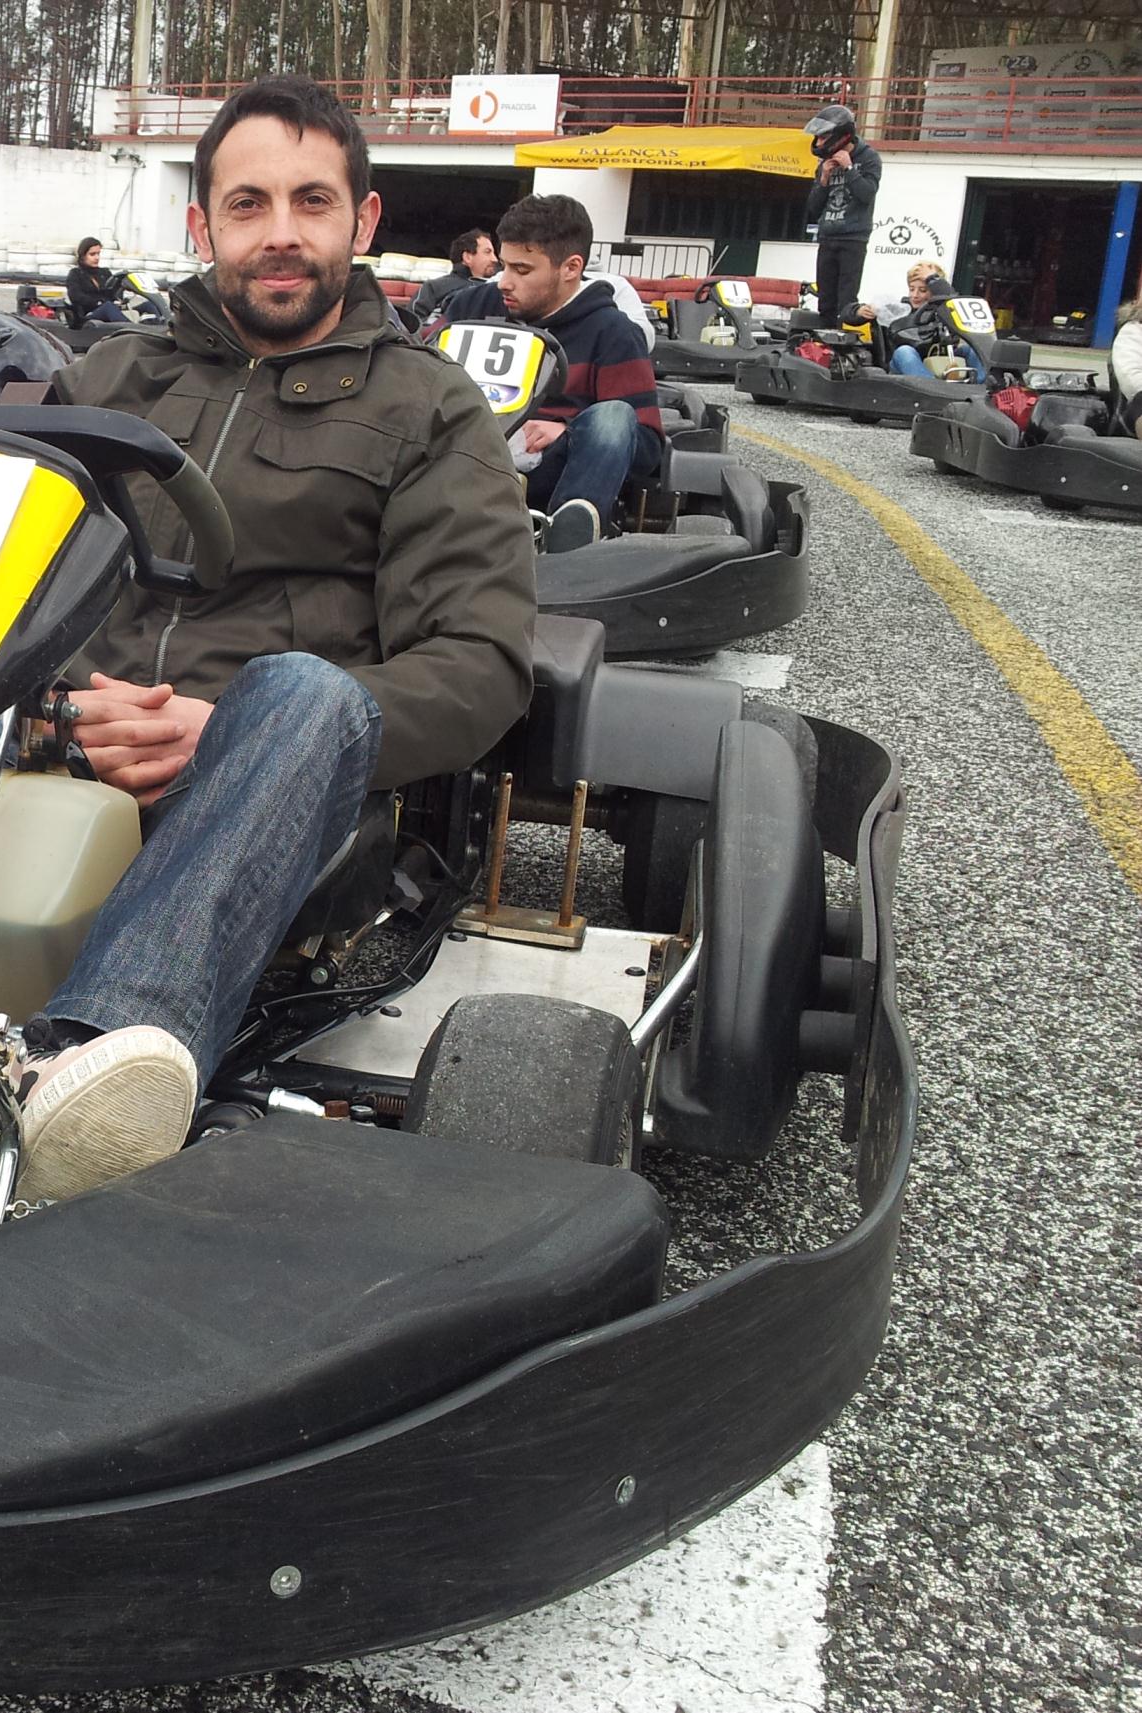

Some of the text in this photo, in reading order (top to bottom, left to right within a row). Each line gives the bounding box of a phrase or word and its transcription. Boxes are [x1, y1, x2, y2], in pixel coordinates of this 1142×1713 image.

[578, 148, 679, 158] BALANÇAS
[550, 157, 707, 167] www.pestronix.pt
[903, 216, 945, 257] KARTING
[874, 245, 925, 256] EUROINDY
[959, 301, 988, 320] 18
[457, 329, 518, 376] 15
